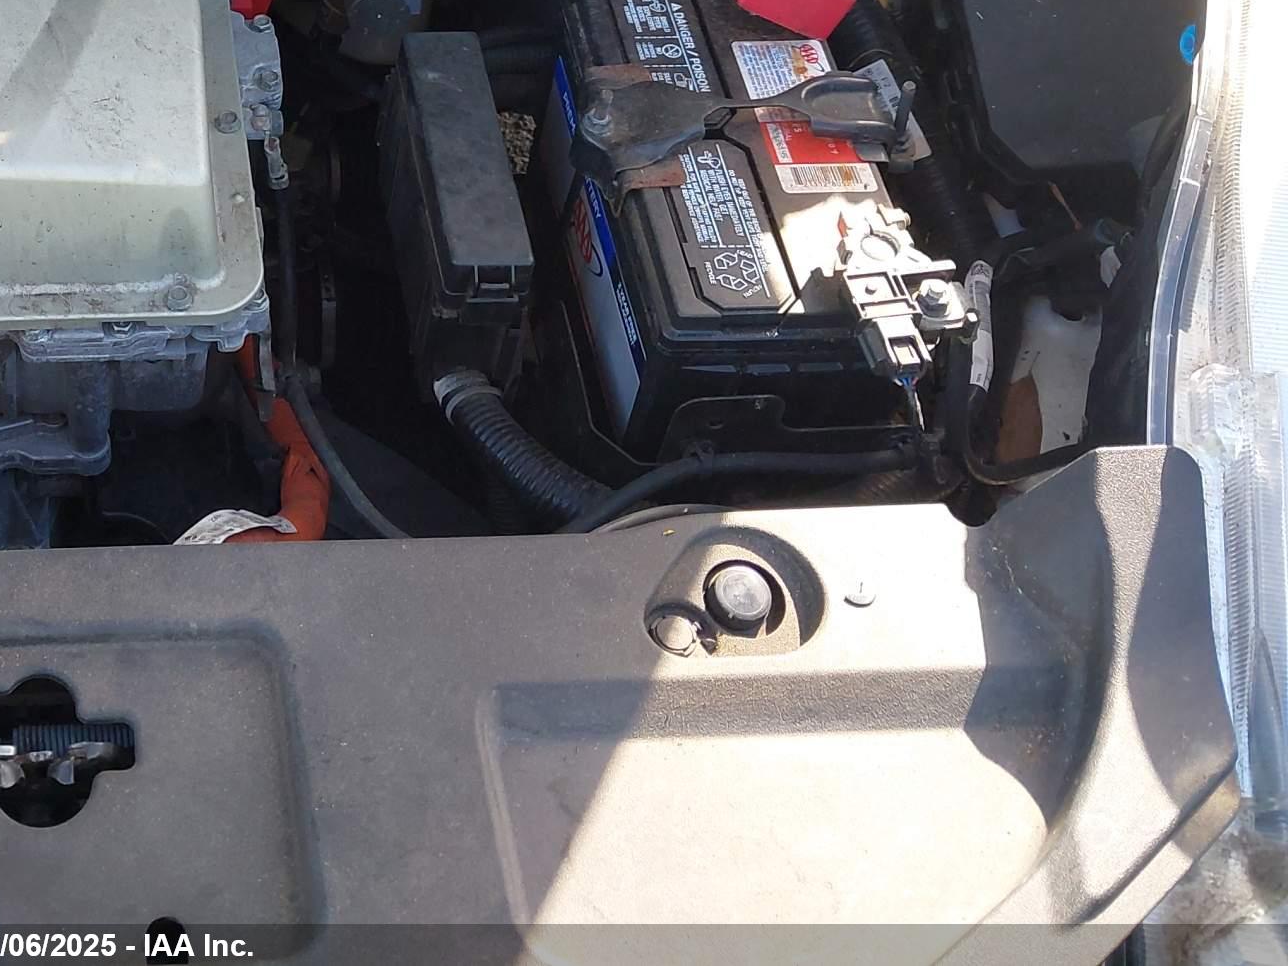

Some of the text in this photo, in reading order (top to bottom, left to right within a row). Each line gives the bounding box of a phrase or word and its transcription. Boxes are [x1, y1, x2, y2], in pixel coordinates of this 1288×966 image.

[673, 12, 696, 48] DANGER
[690, 58, 710, 91] POISON
[699, 169, 713, 191] MEDICAL
[707, 192, 718, 206] HELP
[707, 169, 718, 183] WITH
[719, 204, 729, 214] GET
[715, 169, 744, 236] FLUSH EYES IMMEDIATELY
[704, 262, 716, 284] RECYCLE
